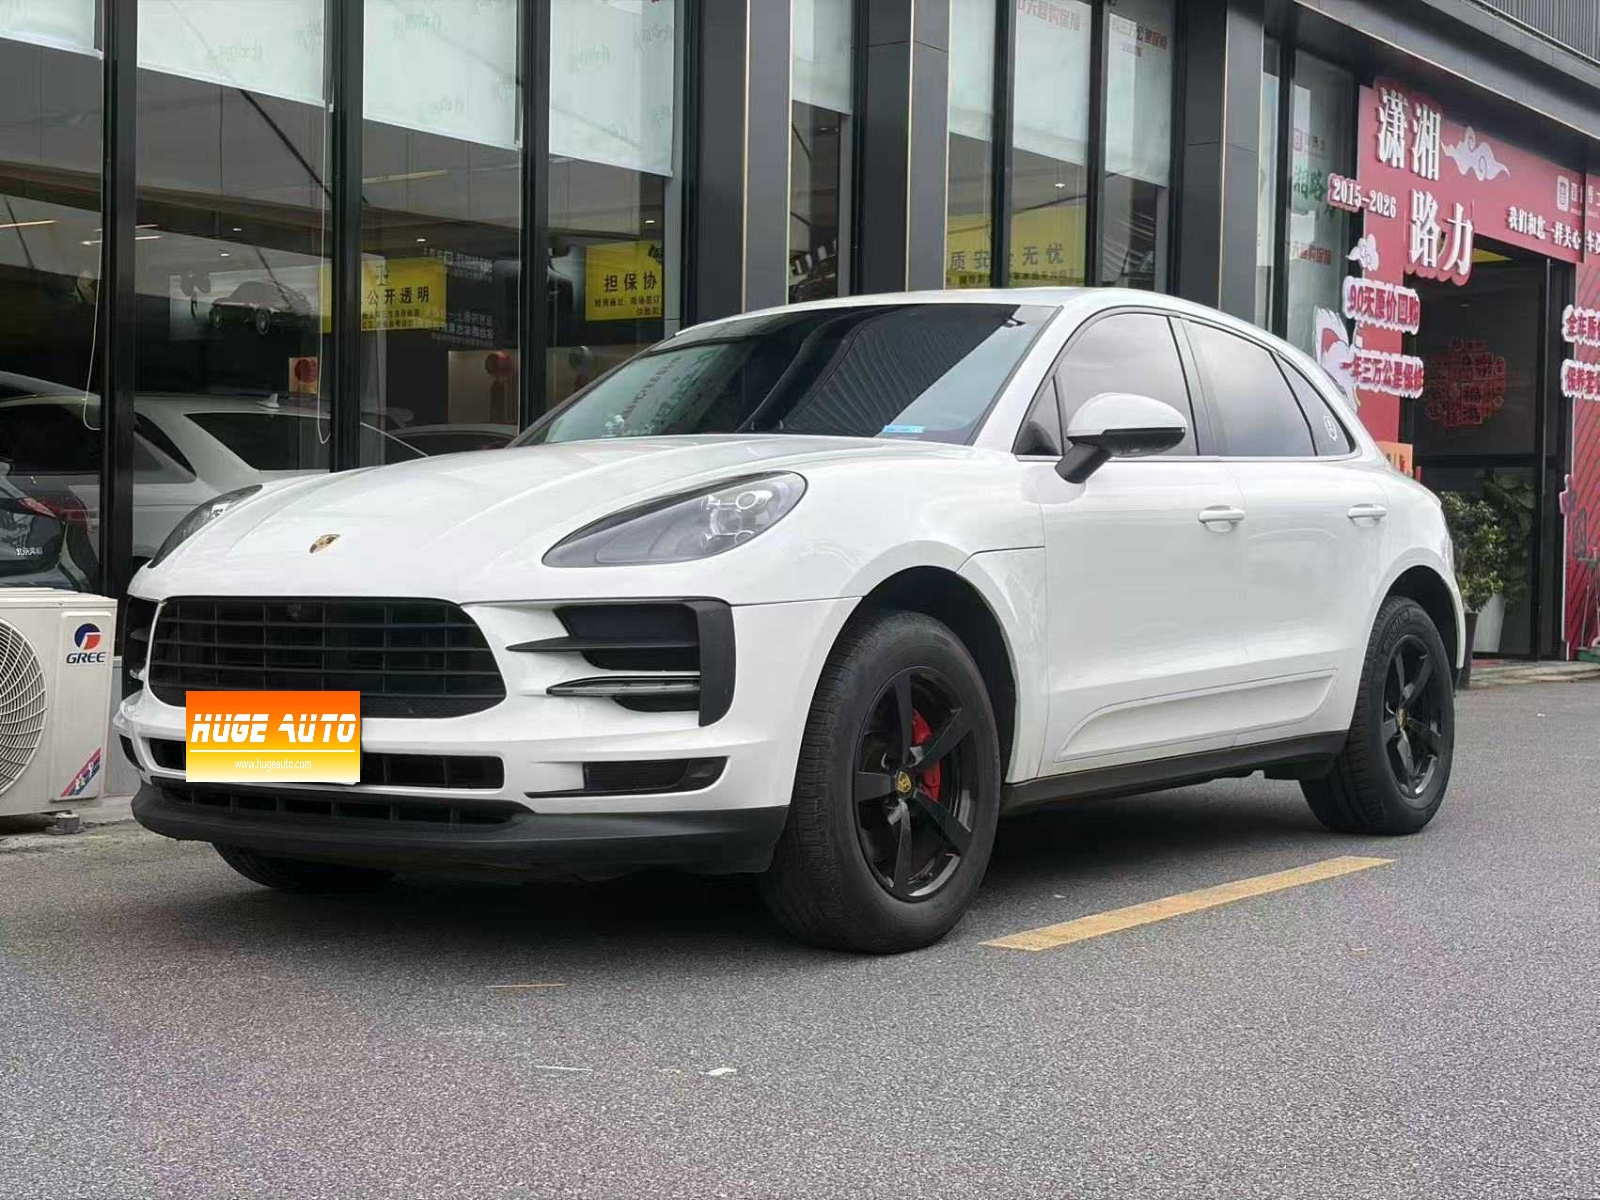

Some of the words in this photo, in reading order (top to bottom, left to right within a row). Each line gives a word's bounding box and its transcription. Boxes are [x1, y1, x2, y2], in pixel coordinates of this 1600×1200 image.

[1377, 87, 1441, 181] 潇湘
[1332, 178, 1397, 219] 2015-2026
[1409, 188, 1474, 276] 路力
[951, 242, 1064, 272] 质安无忧
[367, 286, 430, 306] 公开透明
[605, 271, 657, 293] 担保协
[1347, 284, 1419, 327] 90天原价回购
[1340, 354, 1424, 392] 一年三万公里保修
[66, 651, 106, 664] GREE
